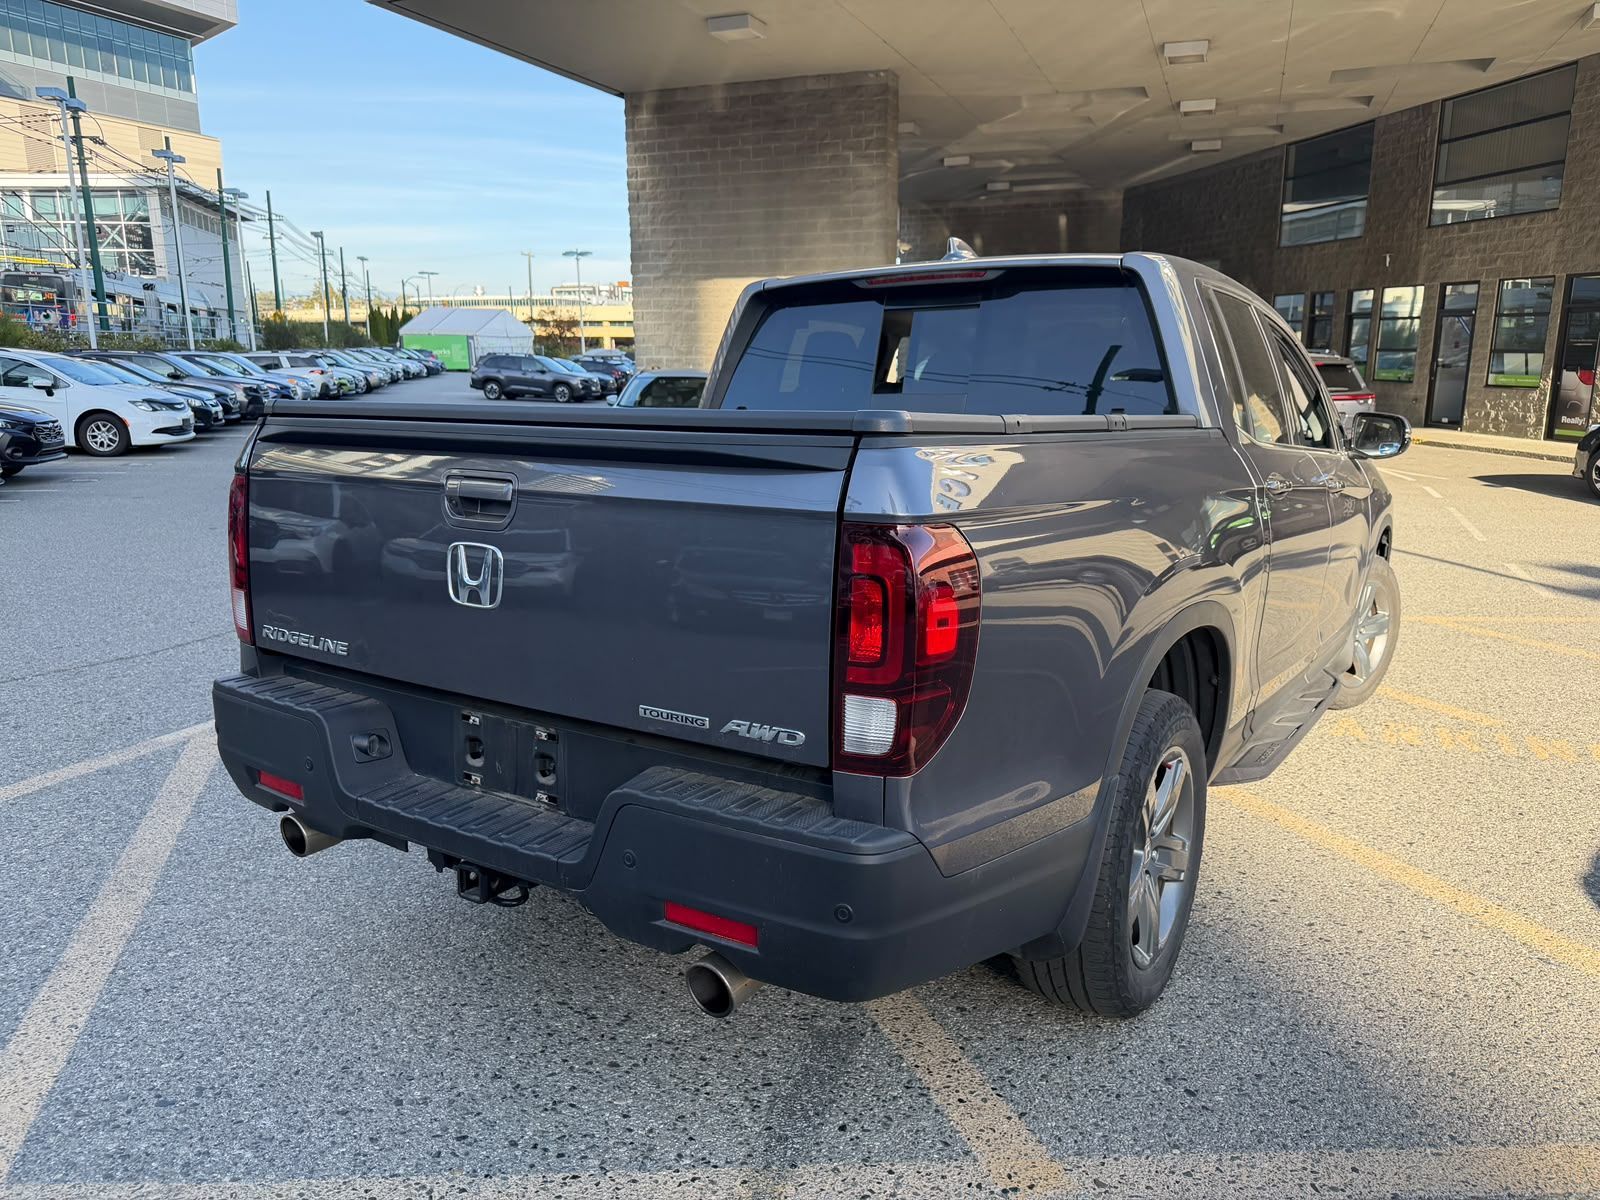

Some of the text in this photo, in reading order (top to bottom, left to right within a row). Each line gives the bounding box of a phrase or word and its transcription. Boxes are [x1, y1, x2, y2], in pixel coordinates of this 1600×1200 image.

[1561, 415, 1586, 425] Really!
[262, 624, 349, 656] RIDGELINE
[640, 706, 706, 728] TOURING
[719, 719, 806, 747] AWD
